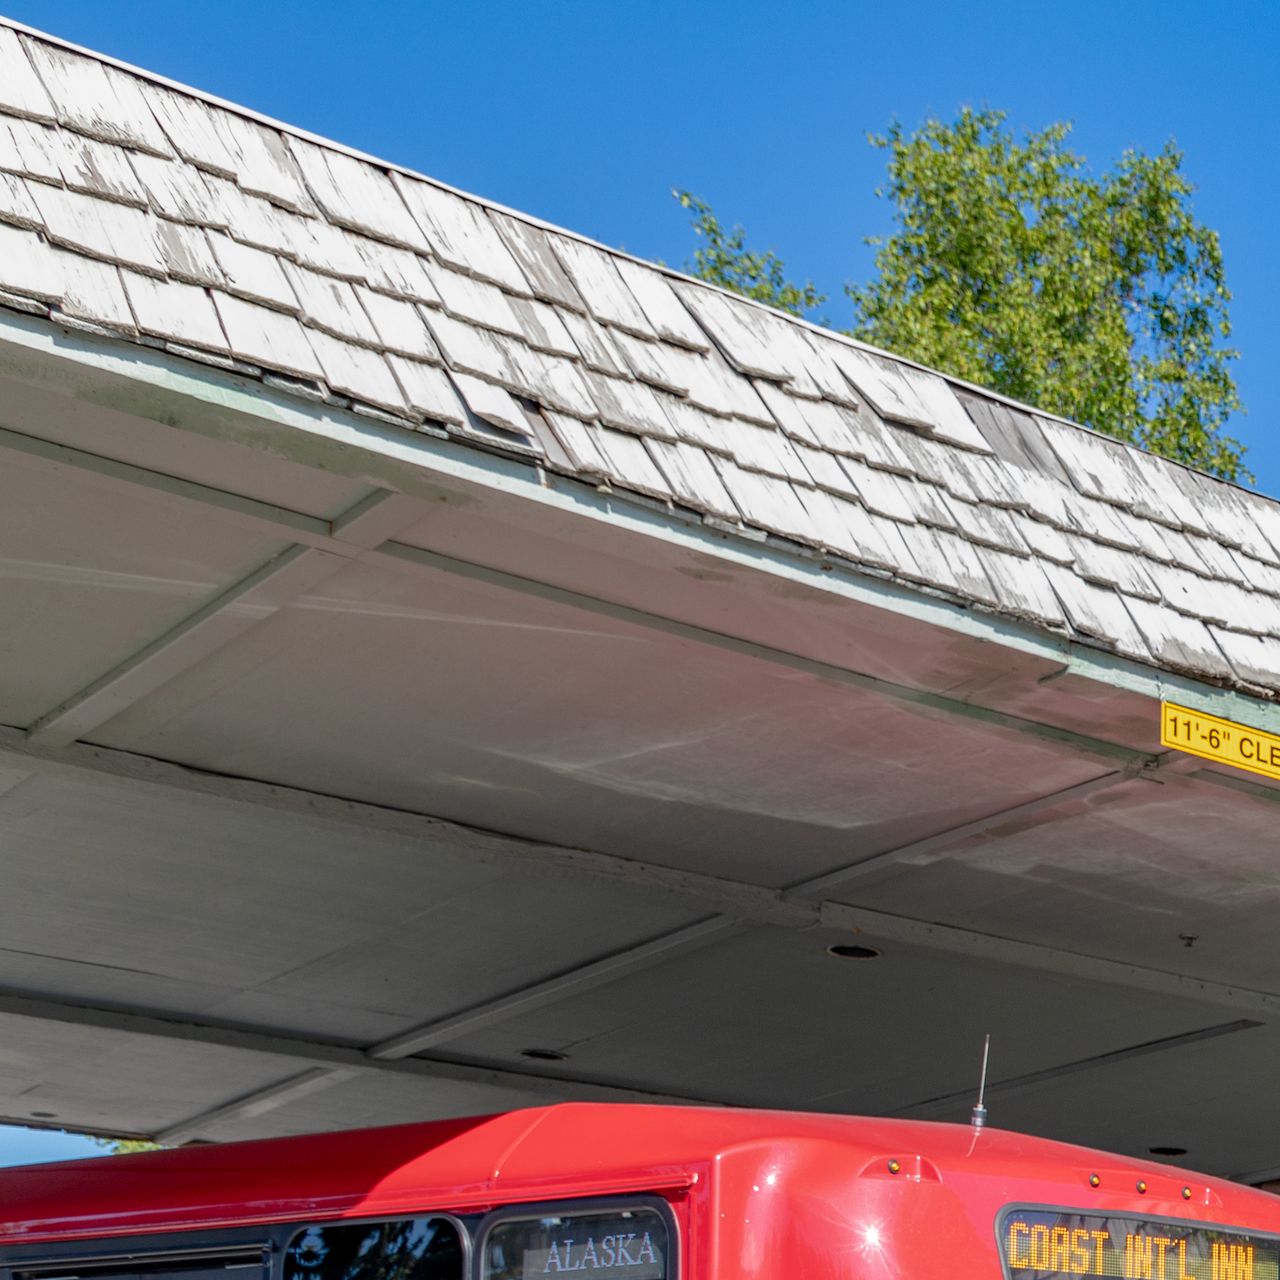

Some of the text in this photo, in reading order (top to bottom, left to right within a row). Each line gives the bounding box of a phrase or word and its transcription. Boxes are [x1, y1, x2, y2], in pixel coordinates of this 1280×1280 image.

[1169, 716, 1230, 749] 11'-6"
[543, 1232, 658, 1272] ALASKA
[1008, 1222, 1109, 1275] COAST
